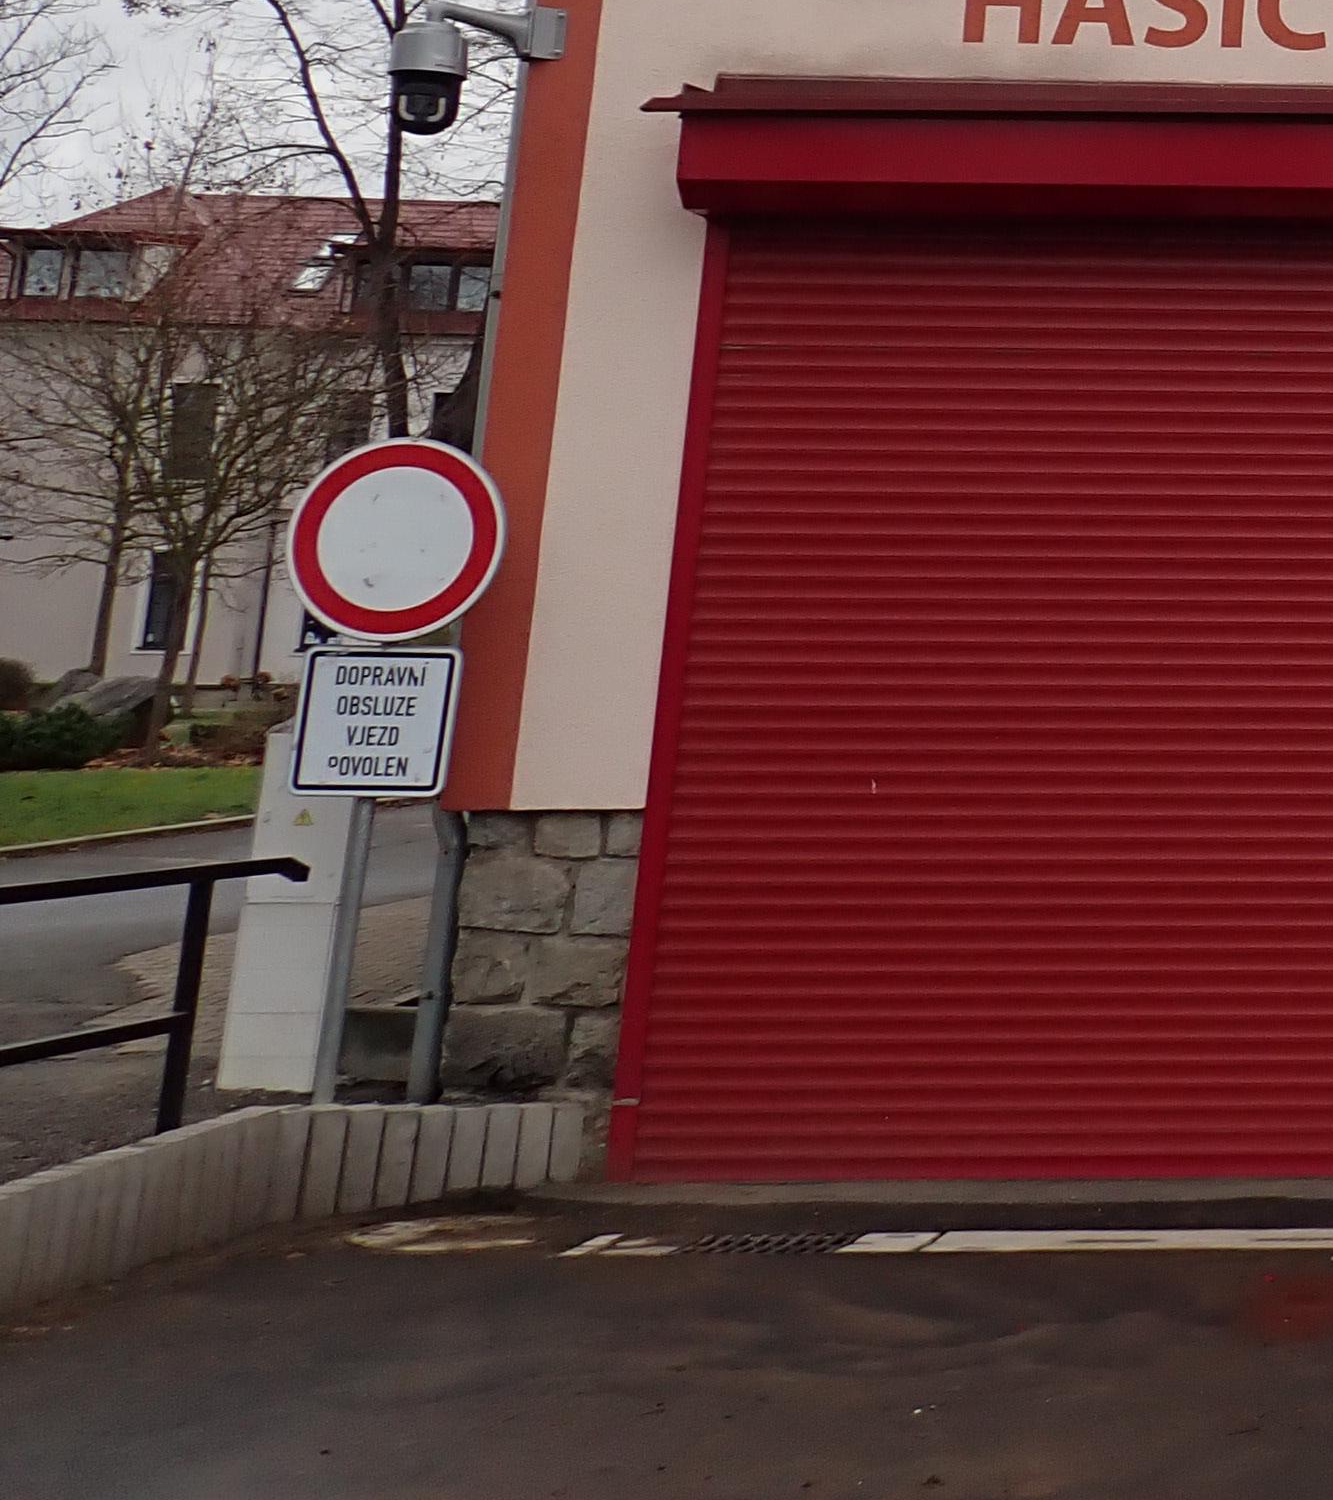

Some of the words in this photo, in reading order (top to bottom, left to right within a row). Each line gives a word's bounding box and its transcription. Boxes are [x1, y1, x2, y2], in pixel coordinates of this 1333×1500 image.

[335, 661, 430, 687] DOPRAVNÍ
[336, 696, 418, 717] OBSLUZE
[347, 726, 399, 747] VJEZD
[328, 756, 408, 777] POVOLEN
